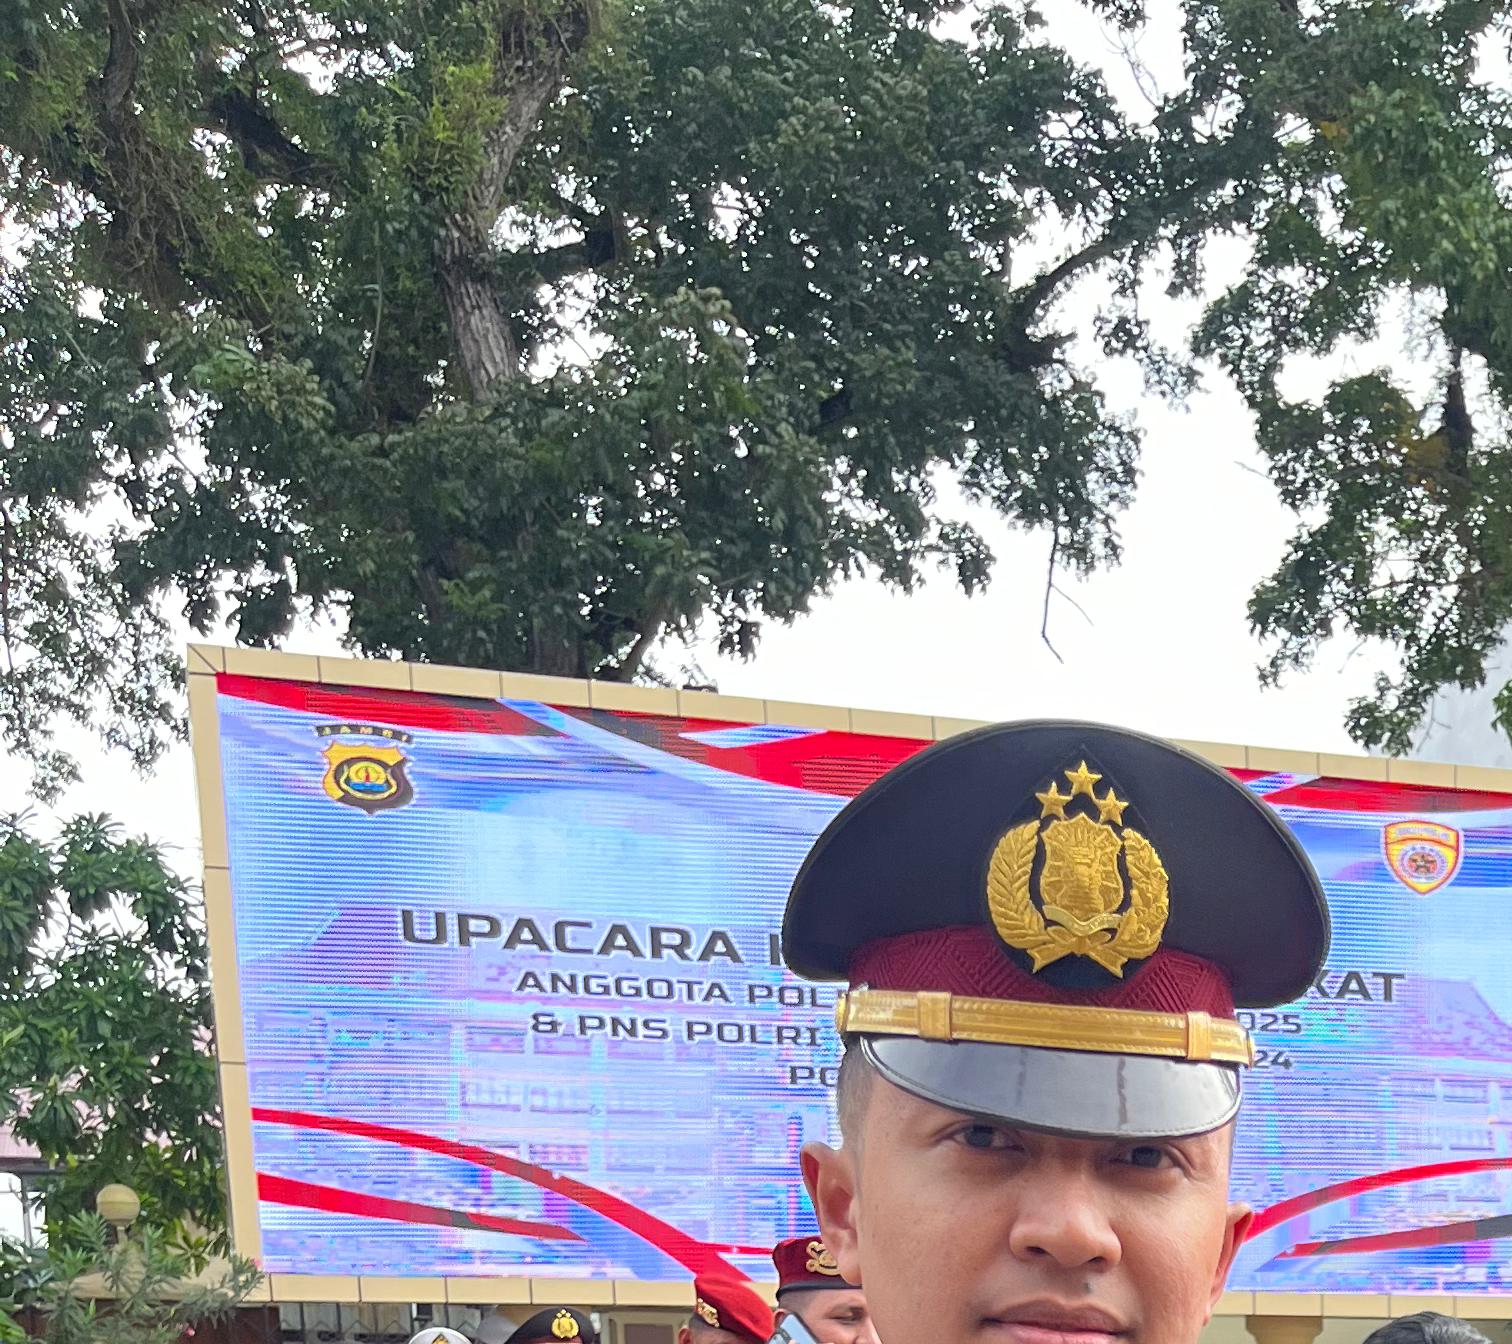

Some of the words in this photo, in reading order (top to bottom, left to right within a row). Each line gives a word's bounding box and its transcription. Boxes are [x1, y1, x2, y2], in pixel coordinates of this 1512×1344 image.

[402, 909, 744, 963] UPACARA
[1315, 970, 1405, 1002] KAT
[515, 971, 732, 1003] ANGGOTA
[748, 984, 842, 1008] POL
[1237, 1011, 1302, 1034] 025
[531, 1012, 562, 1034] &
[579, 1015, 669, 1040] PNS
[686, 1020, 822, 1047] POLRI
[1254, 1050, 1292, 1070] 24
